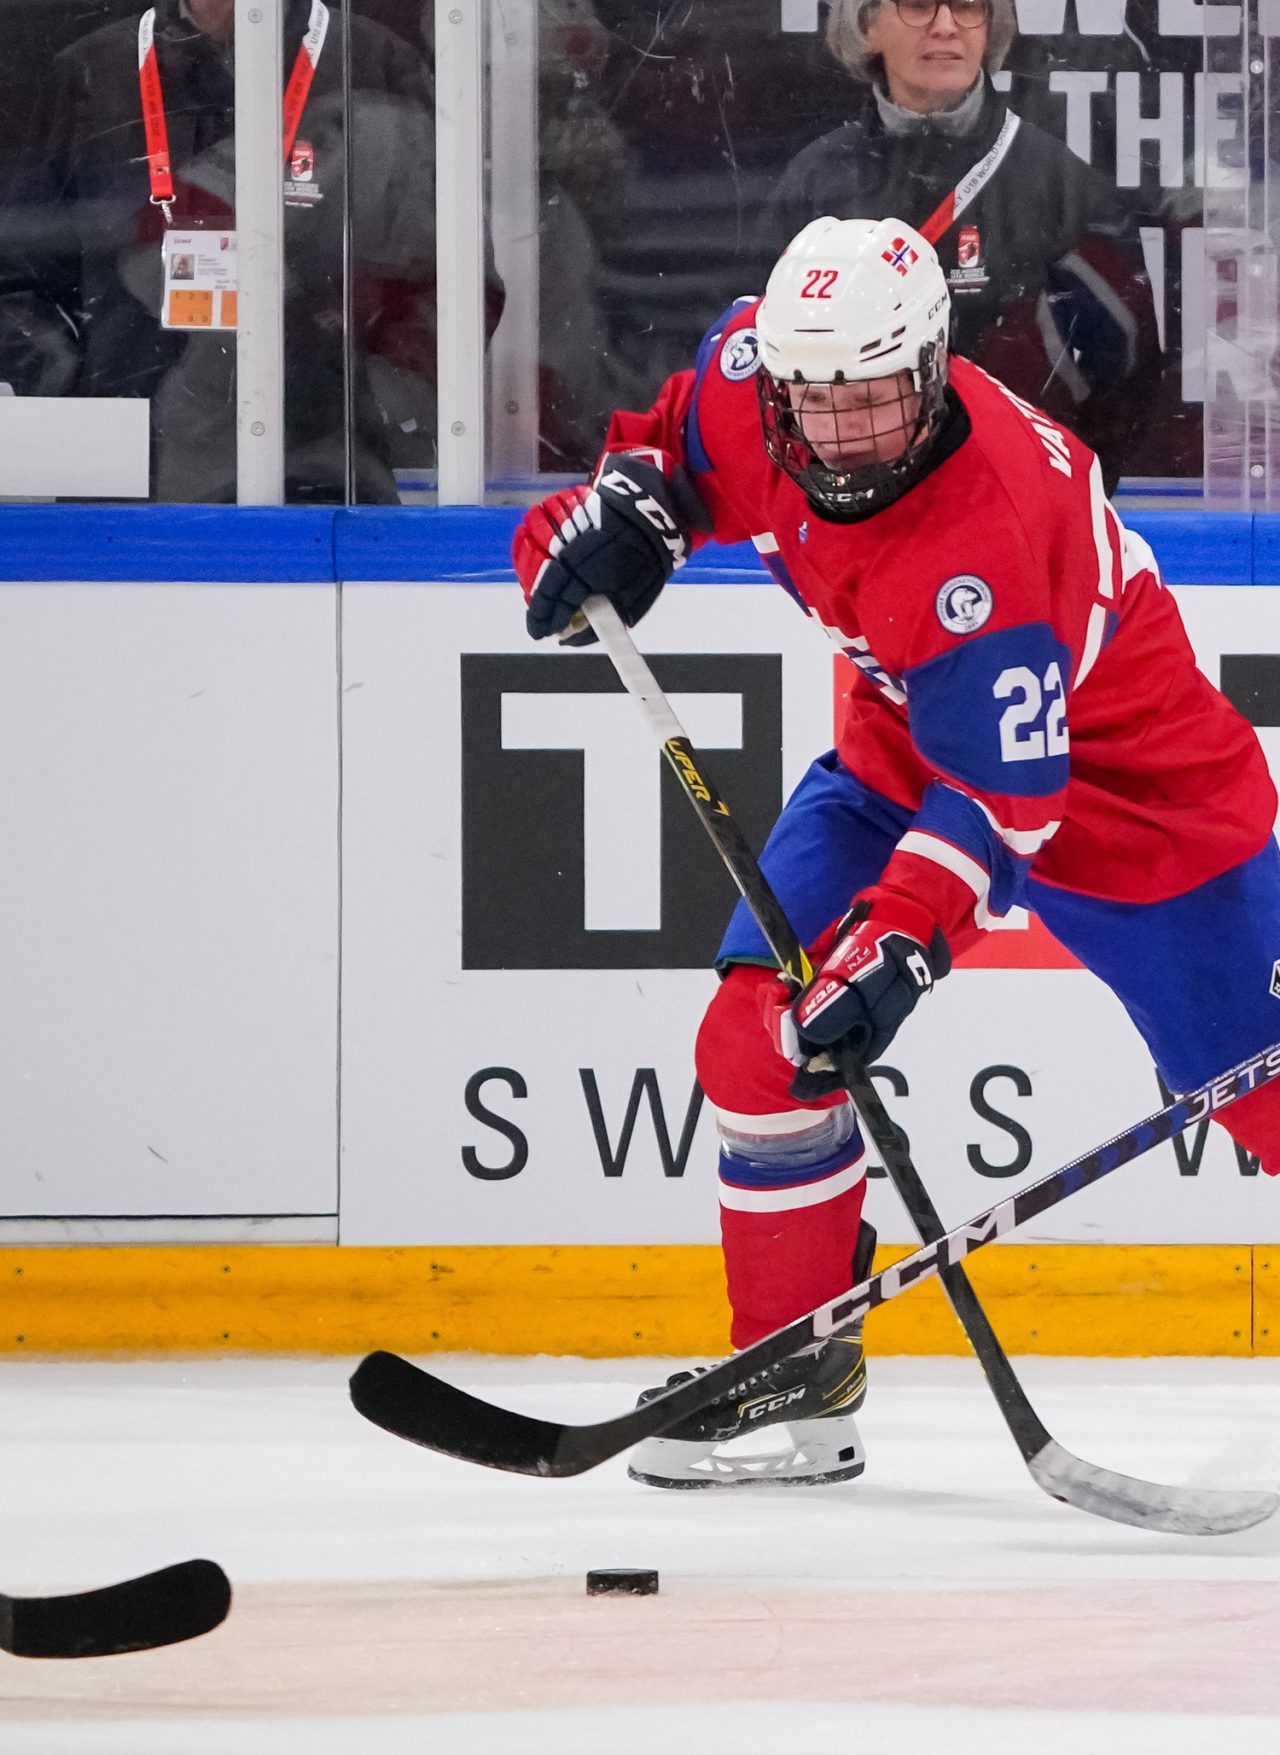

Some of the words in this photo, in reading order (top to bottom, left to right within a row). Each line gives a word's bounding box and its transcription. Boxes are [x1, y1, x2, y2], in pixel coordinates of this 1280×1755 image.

[963, 177, 978, 195] U18
[976, 147, 999, 179] WORLD
[1049, 72, 1246, 187] THE
[800, 270, 838, 298] 22
[600, 469, 687, 570] CCM
[992, 661, 1070, 763] 22
[804, 980, 838, 1015] CCM
[460, 1065, 1034, 1181] SWSS
[813, 1197, 1016, 1337] CCM
[750, 1387, 806, 1419] CCM
